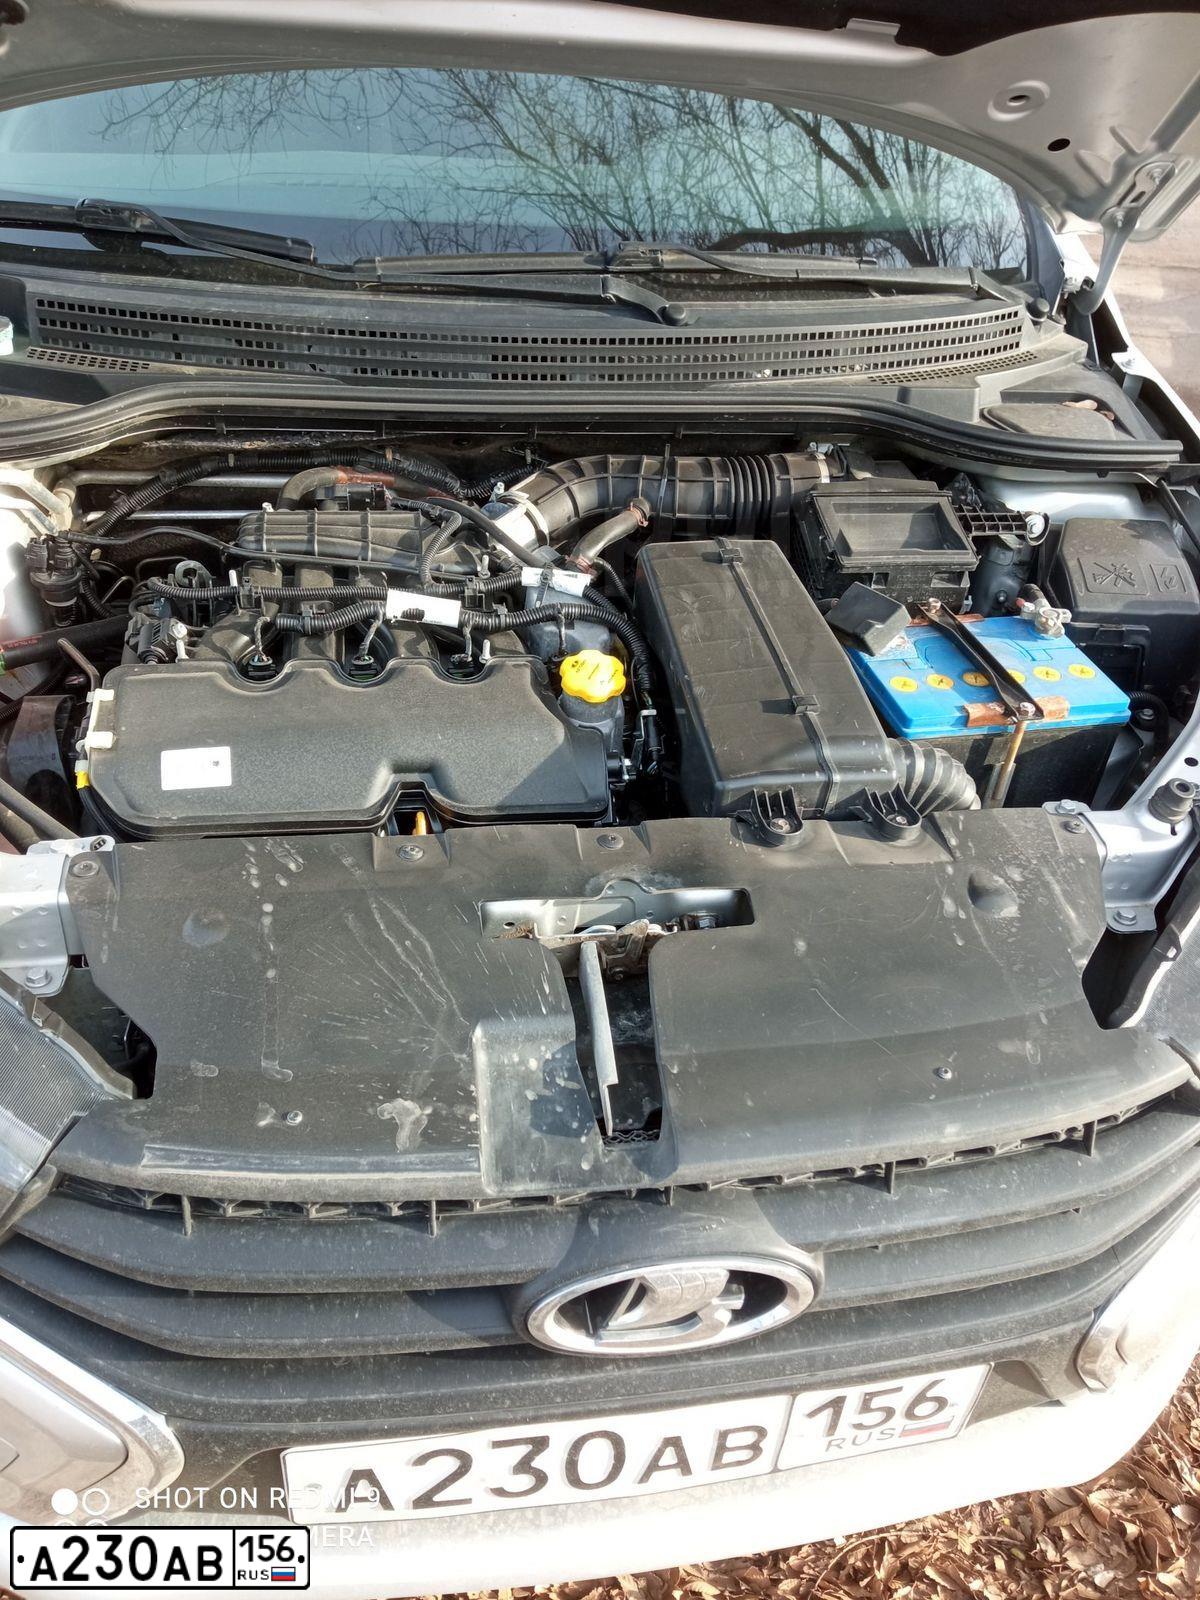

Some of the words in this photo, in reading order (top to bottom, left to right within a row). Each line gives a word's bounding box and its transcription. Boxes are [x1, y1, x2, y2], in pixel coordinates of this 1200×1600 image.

[335, 1424, 767, 1513] A230AB
[806, 1378, 947, 1437] 156
[825, 1427, 895, 1452] RUS
